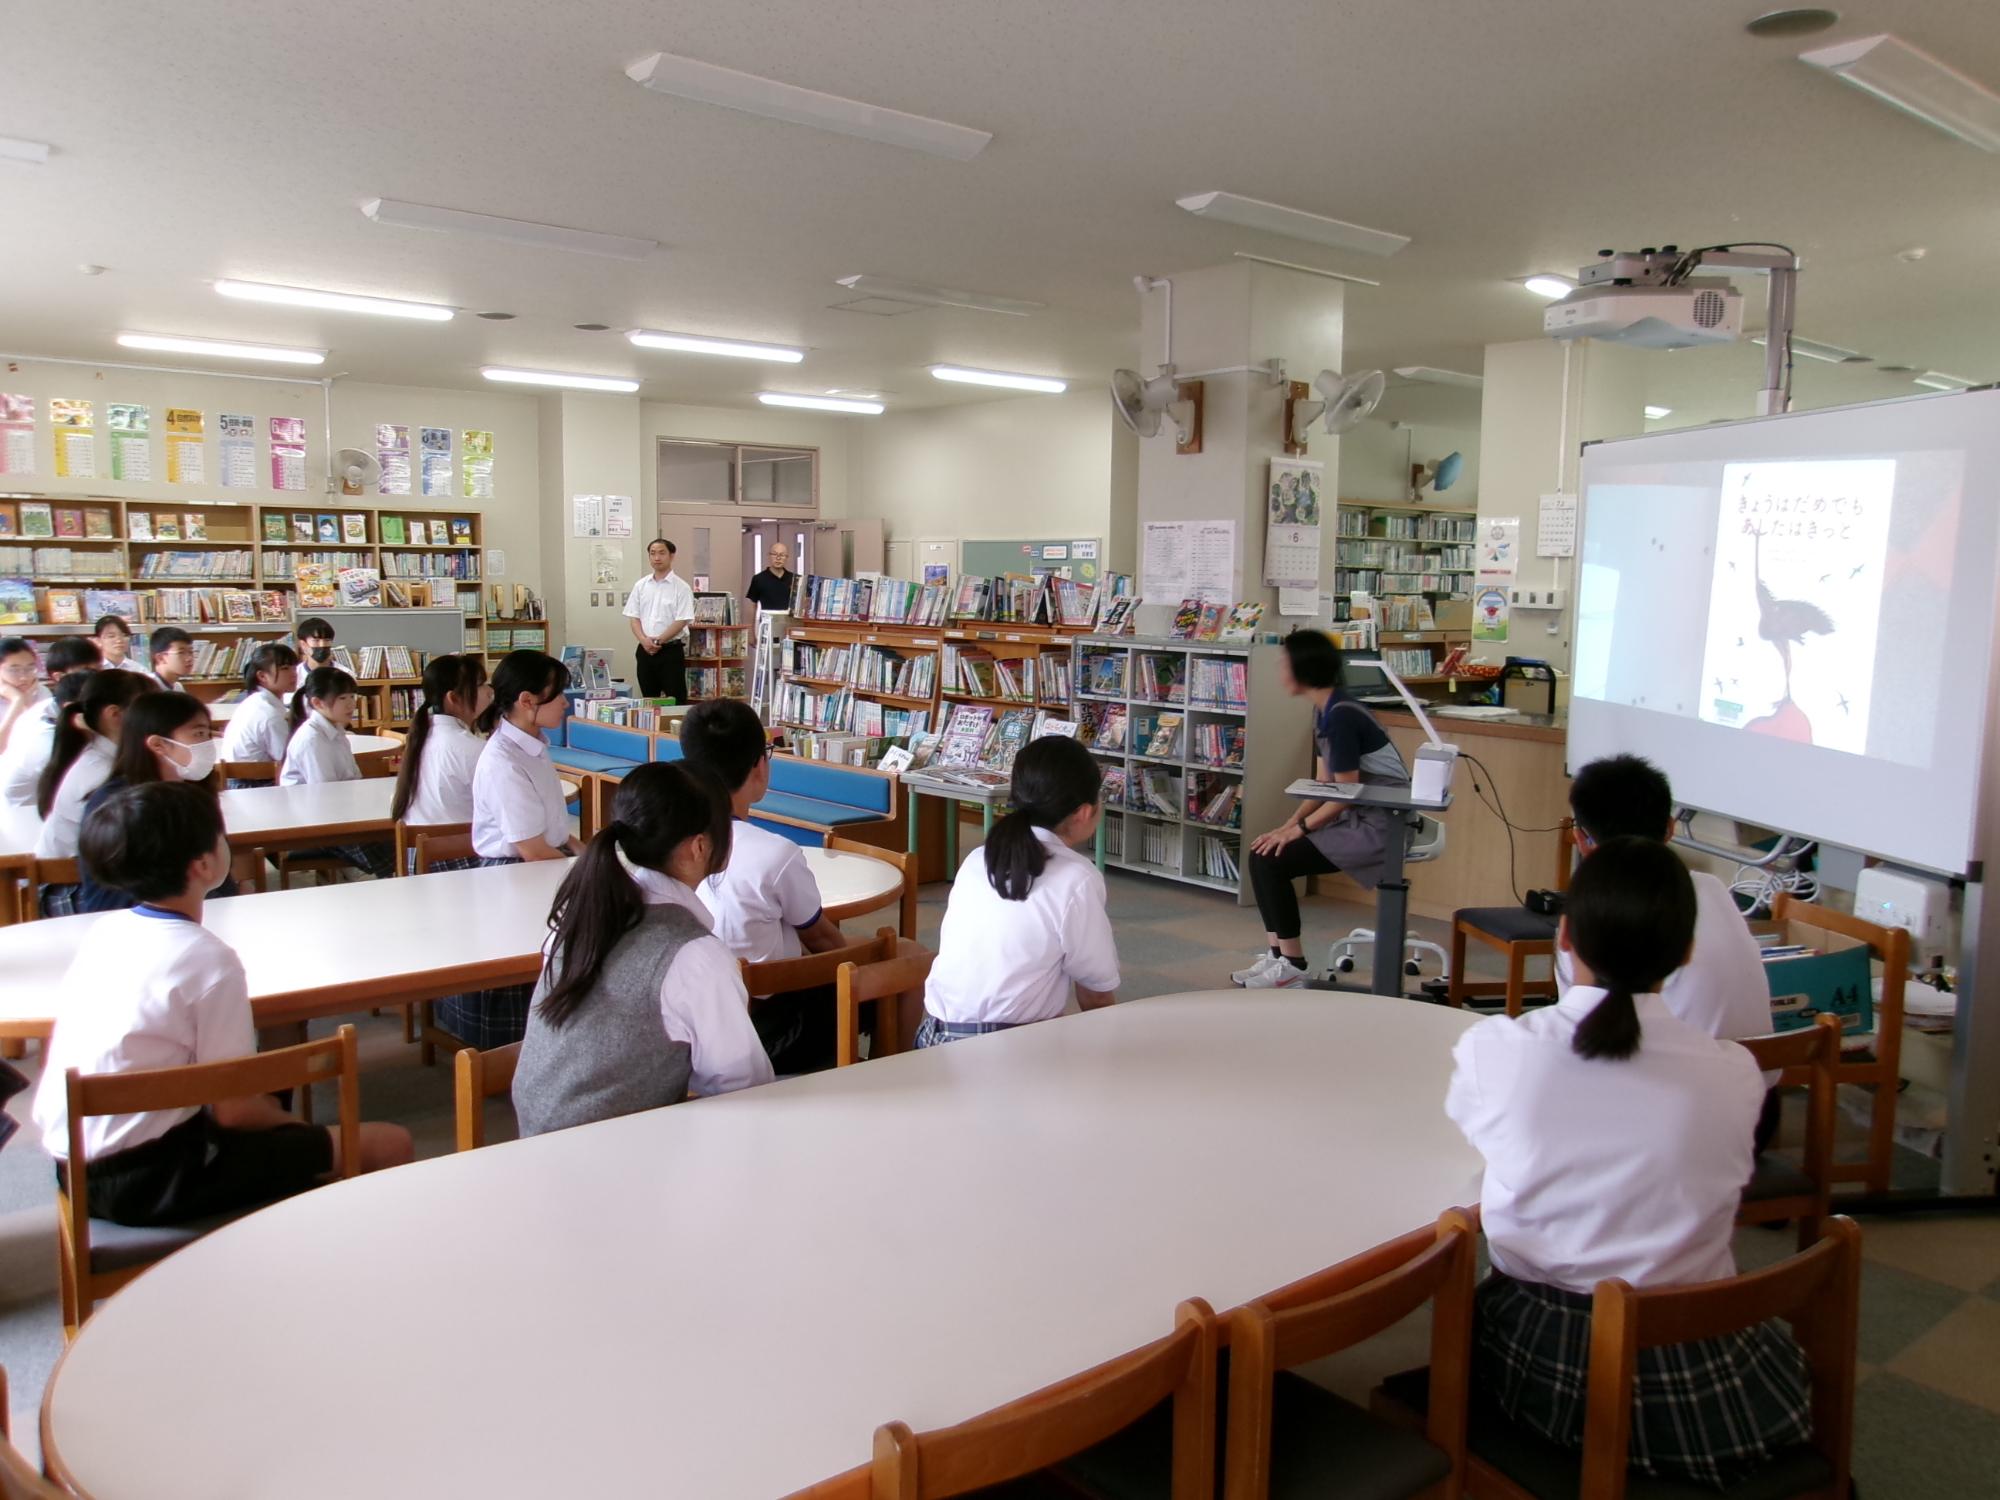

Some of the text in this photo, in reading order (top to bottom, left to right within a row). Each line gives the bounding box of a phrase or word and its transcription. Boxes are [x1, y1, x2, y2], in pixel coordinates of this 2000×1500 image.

[219, 414, 229, 430] 5
[1738, 494, 1863, 515] きょうはだめでも
[1292, 532, 1299, 543] 6
[1741, 518, 1851, 539] あしたはきっと
[1830, 984, 1858, 1007] A4
